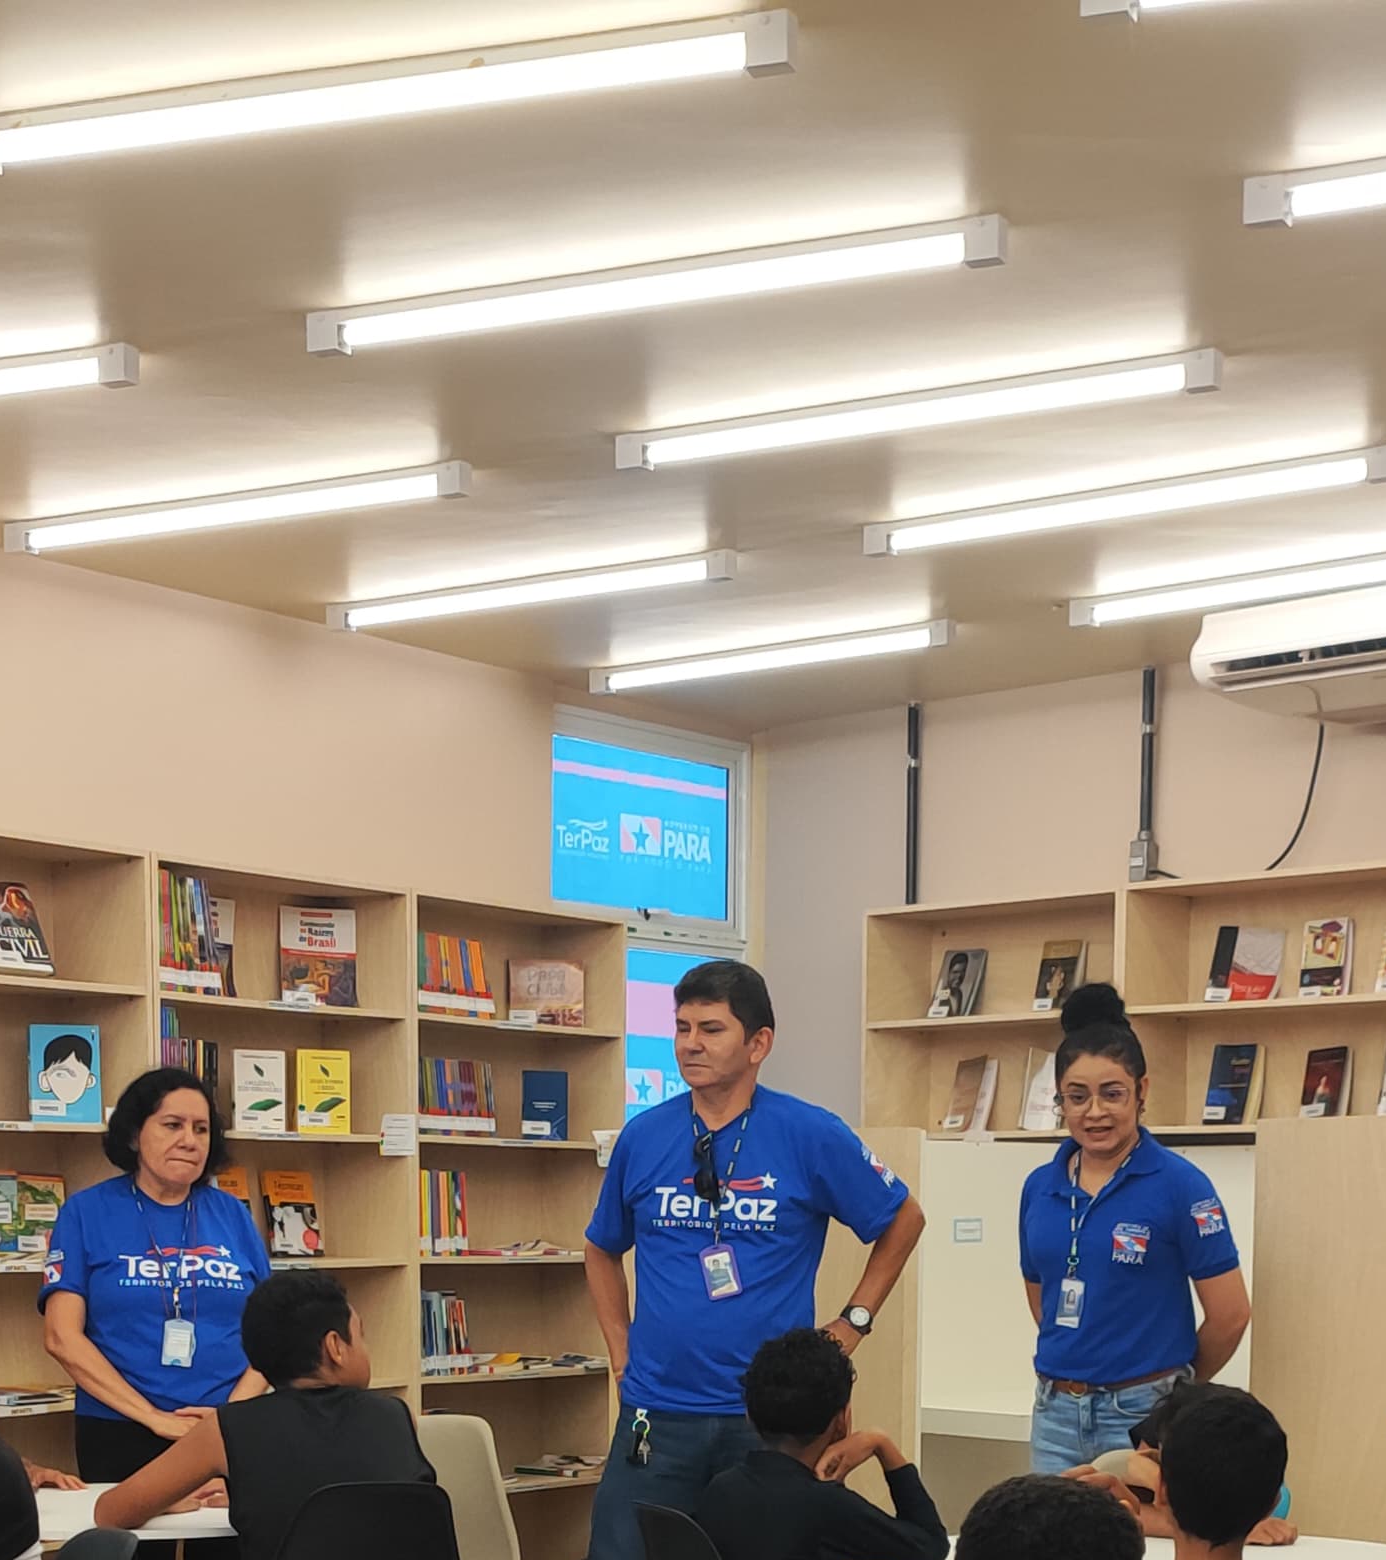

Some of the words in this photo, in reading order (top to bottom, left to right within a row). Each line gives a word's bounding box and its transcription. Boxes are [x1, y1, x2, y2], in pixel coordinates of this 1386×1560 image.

[556, 824, 610, 853] TerPaz
[724, 1222, 751, 1232] PELA
[755, 1223, 775, 1232] PAZ
[118, 1254, 243, 1281] TerPaz
[197, 1279, 224, 1288] PELA
